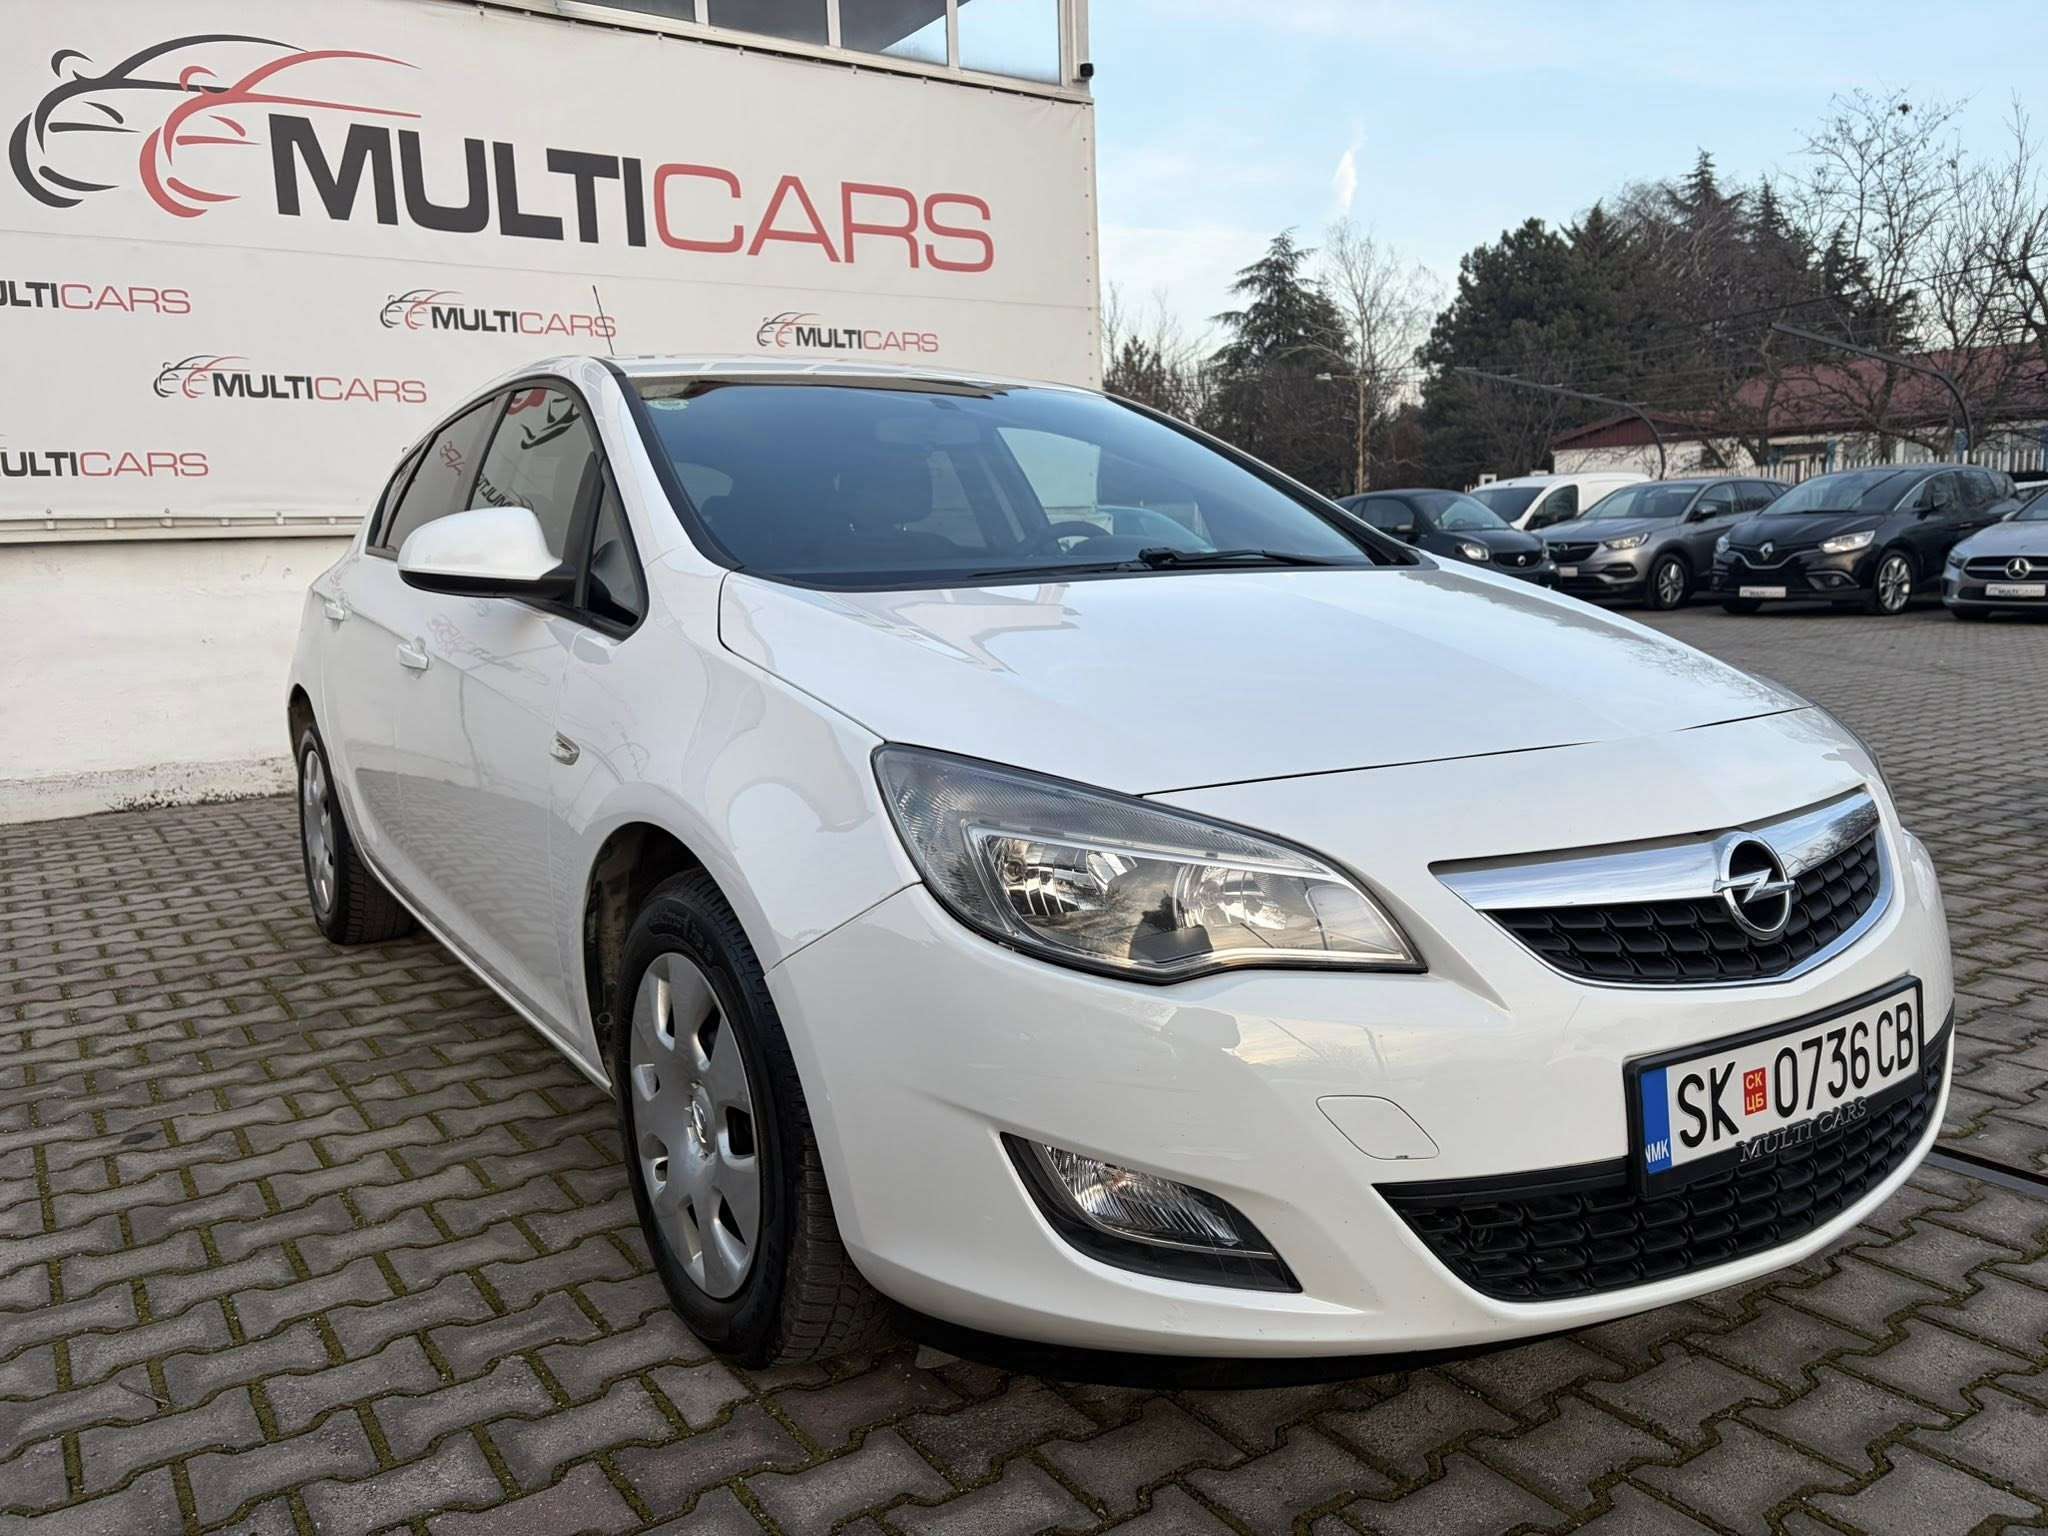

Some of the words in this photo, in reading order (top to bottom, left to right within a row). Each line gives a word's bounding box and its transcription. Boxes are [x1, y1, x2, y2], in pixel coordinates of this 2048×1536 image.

[268, 113, 995, 273] MULTICARS
[431, 306, 617, 338] MULTICARS
[795, 326, 939, 353] MULTICARS
[212, 372, 427, 403] MULTICARS
[1677, 1062, 1740, 1148] SK
[1740, 1121, 1814, 1162] MULTI
[1818, 1098, 1867, 1132] CARS
